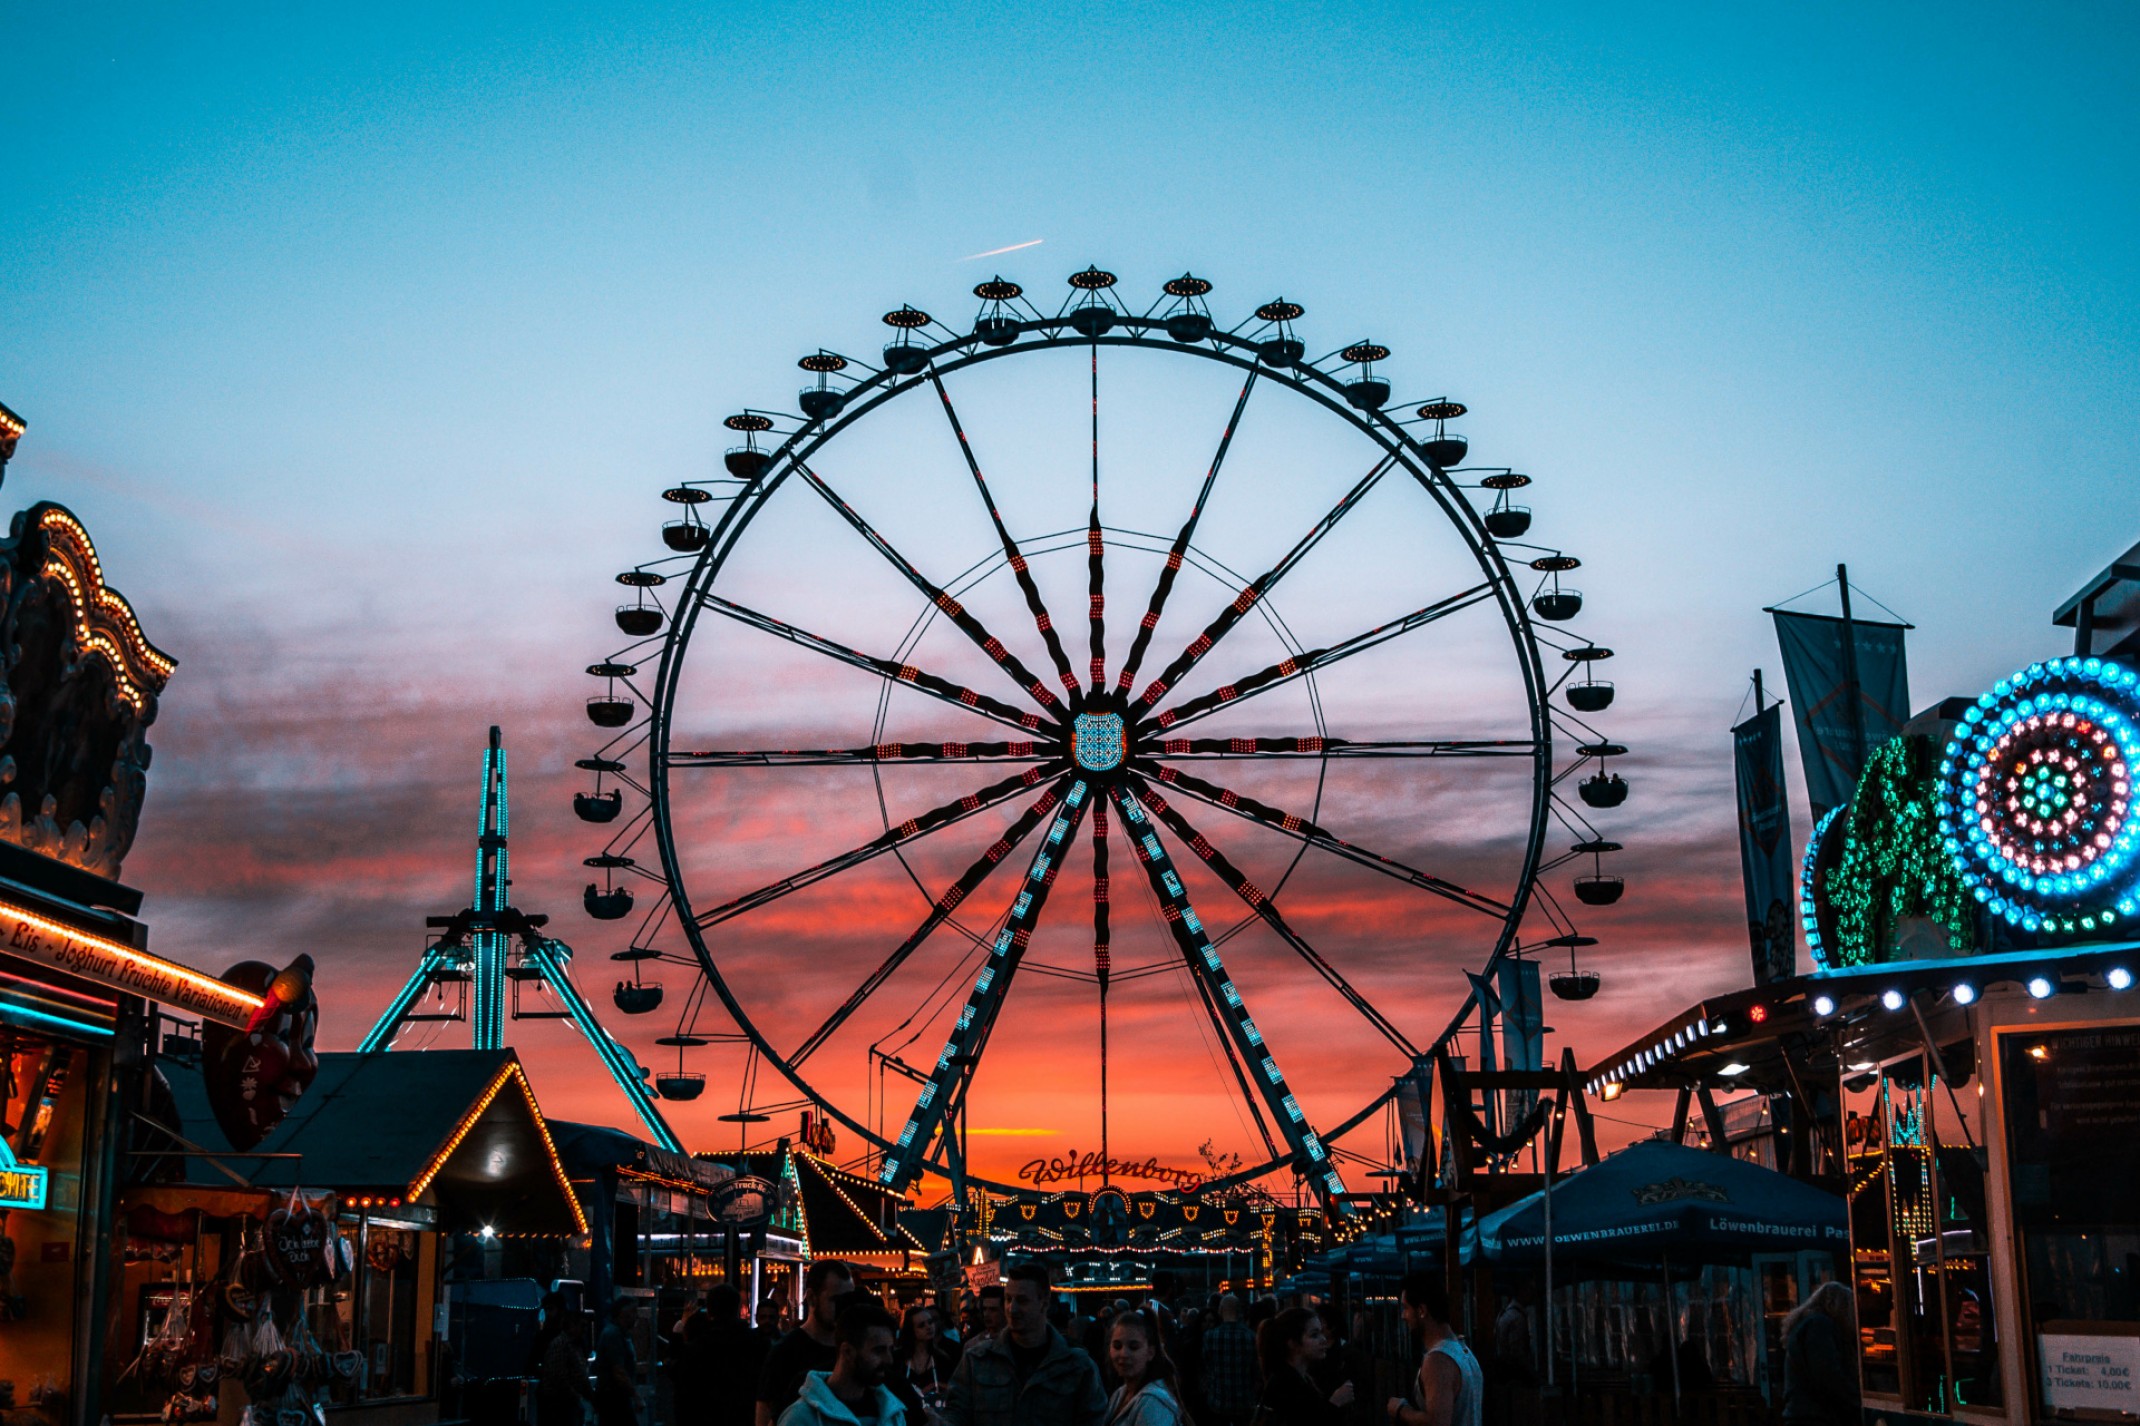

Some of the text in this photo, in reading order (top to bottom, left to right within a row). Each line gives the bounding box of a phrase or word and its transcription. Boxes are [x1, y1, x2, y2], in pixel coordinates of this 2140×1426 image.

[9, 921, 243, 1020] Eis Joghurt Früchte Variationen
[1018, 1149, 1202, 1195] Willenborg
[1507, 1220, 1681, 1248] WWWOEWENBRAUEREI.DE
[1709, 1216, 1817, 1238] Löwenbrauerei
[2062, 1352, 2111, 1364] Fahrpreis
[2056, 1365, 2089, 1375] Ticket:
[2054, 1377, 2094, 1388] Tickets:
